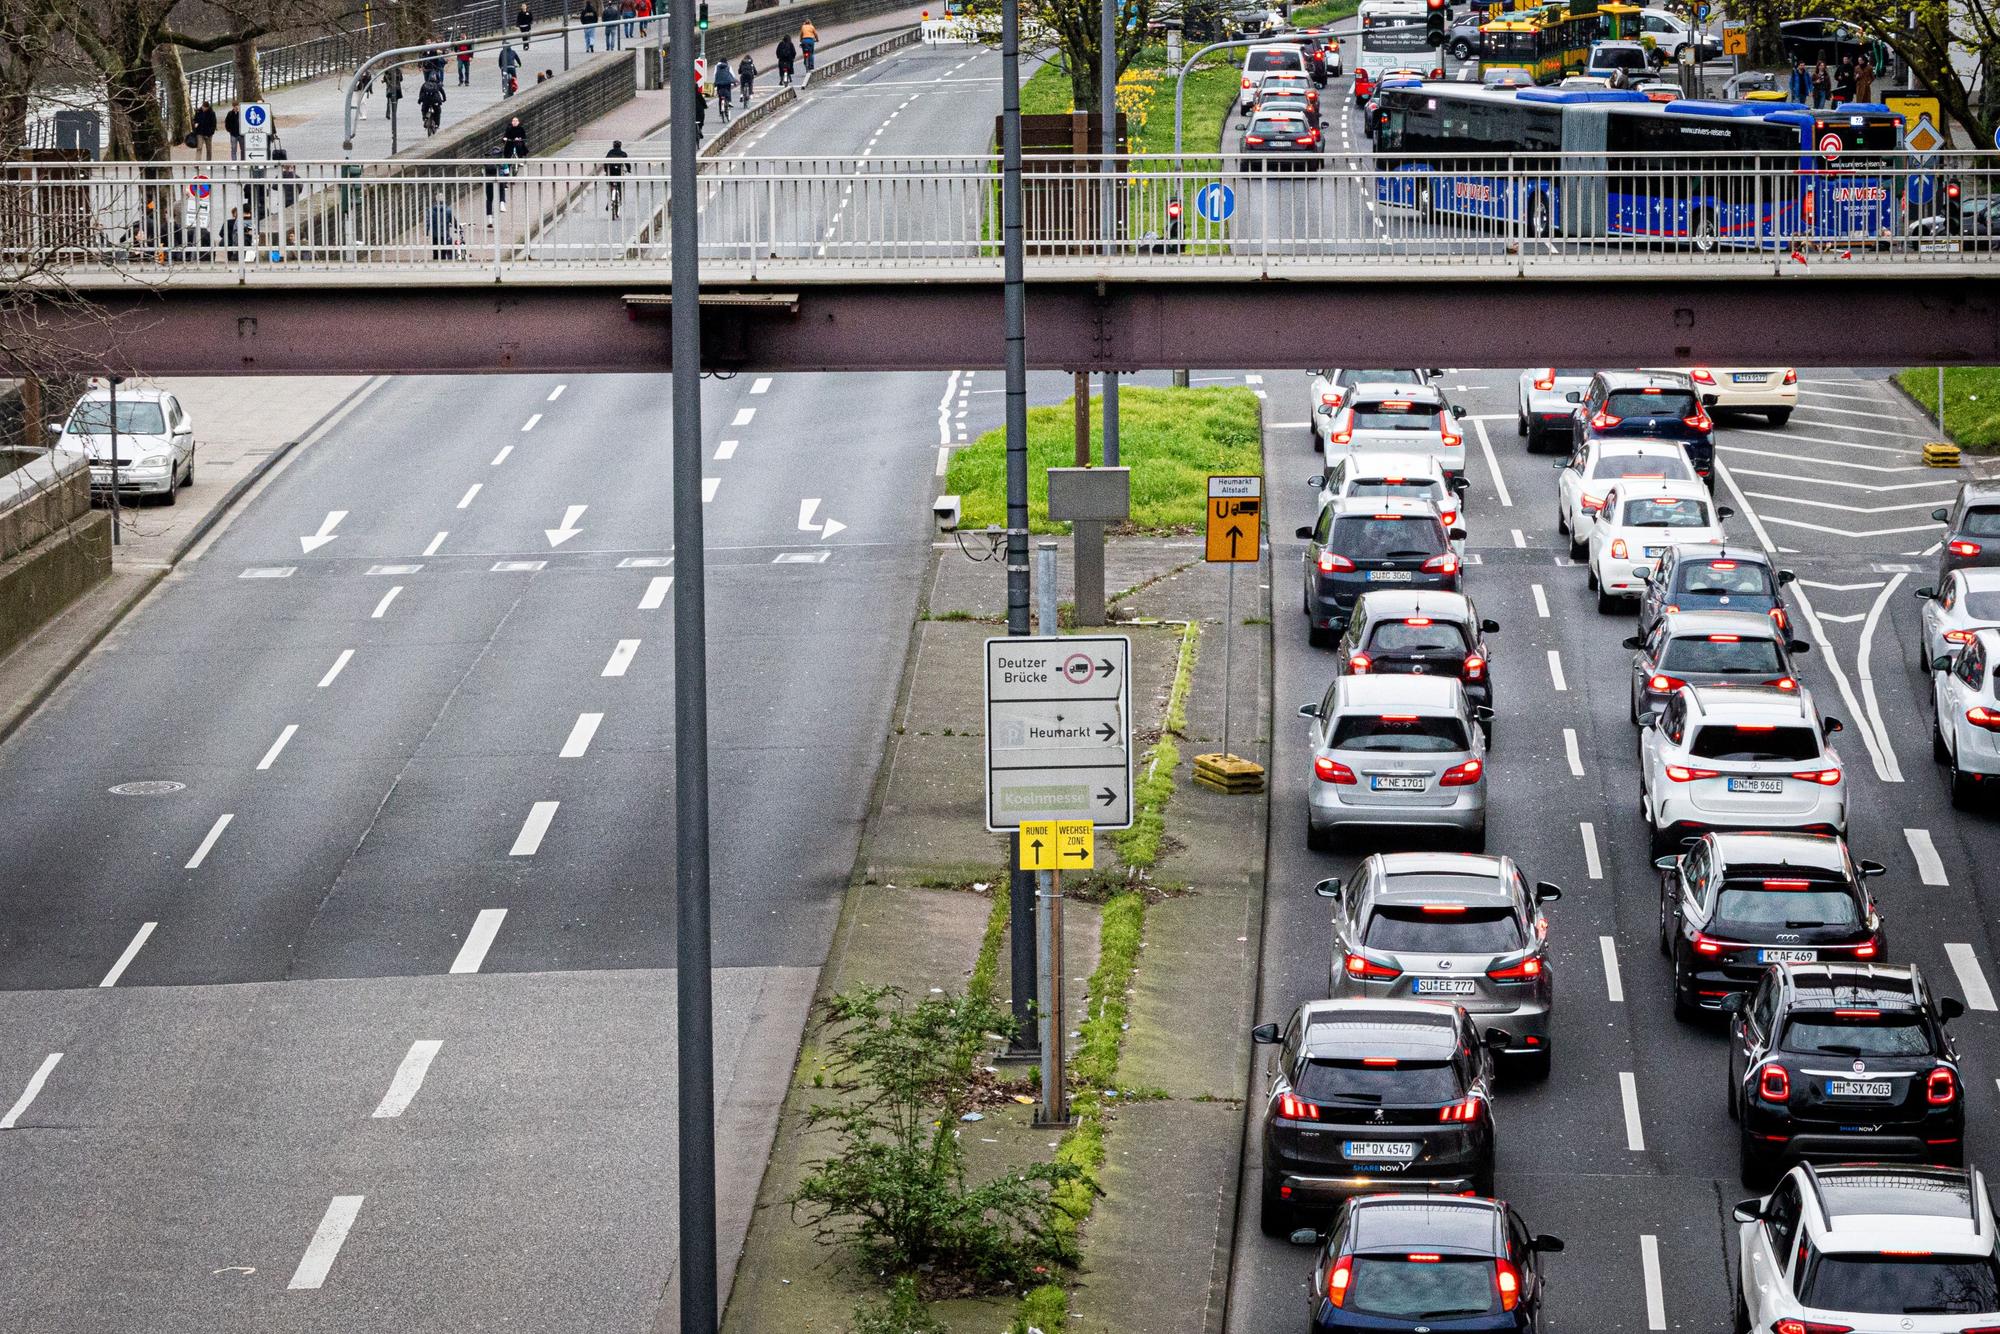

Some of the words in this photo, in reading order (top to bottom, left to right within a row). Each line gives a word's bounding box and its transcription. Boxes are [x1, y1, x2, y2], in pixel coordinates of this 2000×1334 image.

[1833, 187, 1887, 201] UNVERS
[1216, 501, 1229, 519] U
[998, 657, 1047, 669] Deutzer
[1004, 671, 1048, 683] Brücke
[1030, 727, 1091, 738] Heumarkt
[1402, 779, 1423, 787] 1701
[1005, 792, 1085, 805] Koelnmesse
[1025, 826, 1048, 835] RUNDE
[1067, 836, 1085, 845] ZONE
[1767, 951, 1773, 960] K
[1780, 952, 1793, 960] AF
[1794, 952, 1813, 962] 469
[1420, 980, 1433, 990] SU
[1440, 981, 1452, 990] EE
[1455, 981, 1473, 991] 777
[1833, 1083, 1845, 1093] HH
[1852, 1083, 1864, 1094] SX
[1866, 1084, 1890, 1095] 7603
[1352, 1144, 1365, 1154] HH
[1372, 1144, 1384, 1154] QX
[1387, 1144, 1411, 1155] 4547
